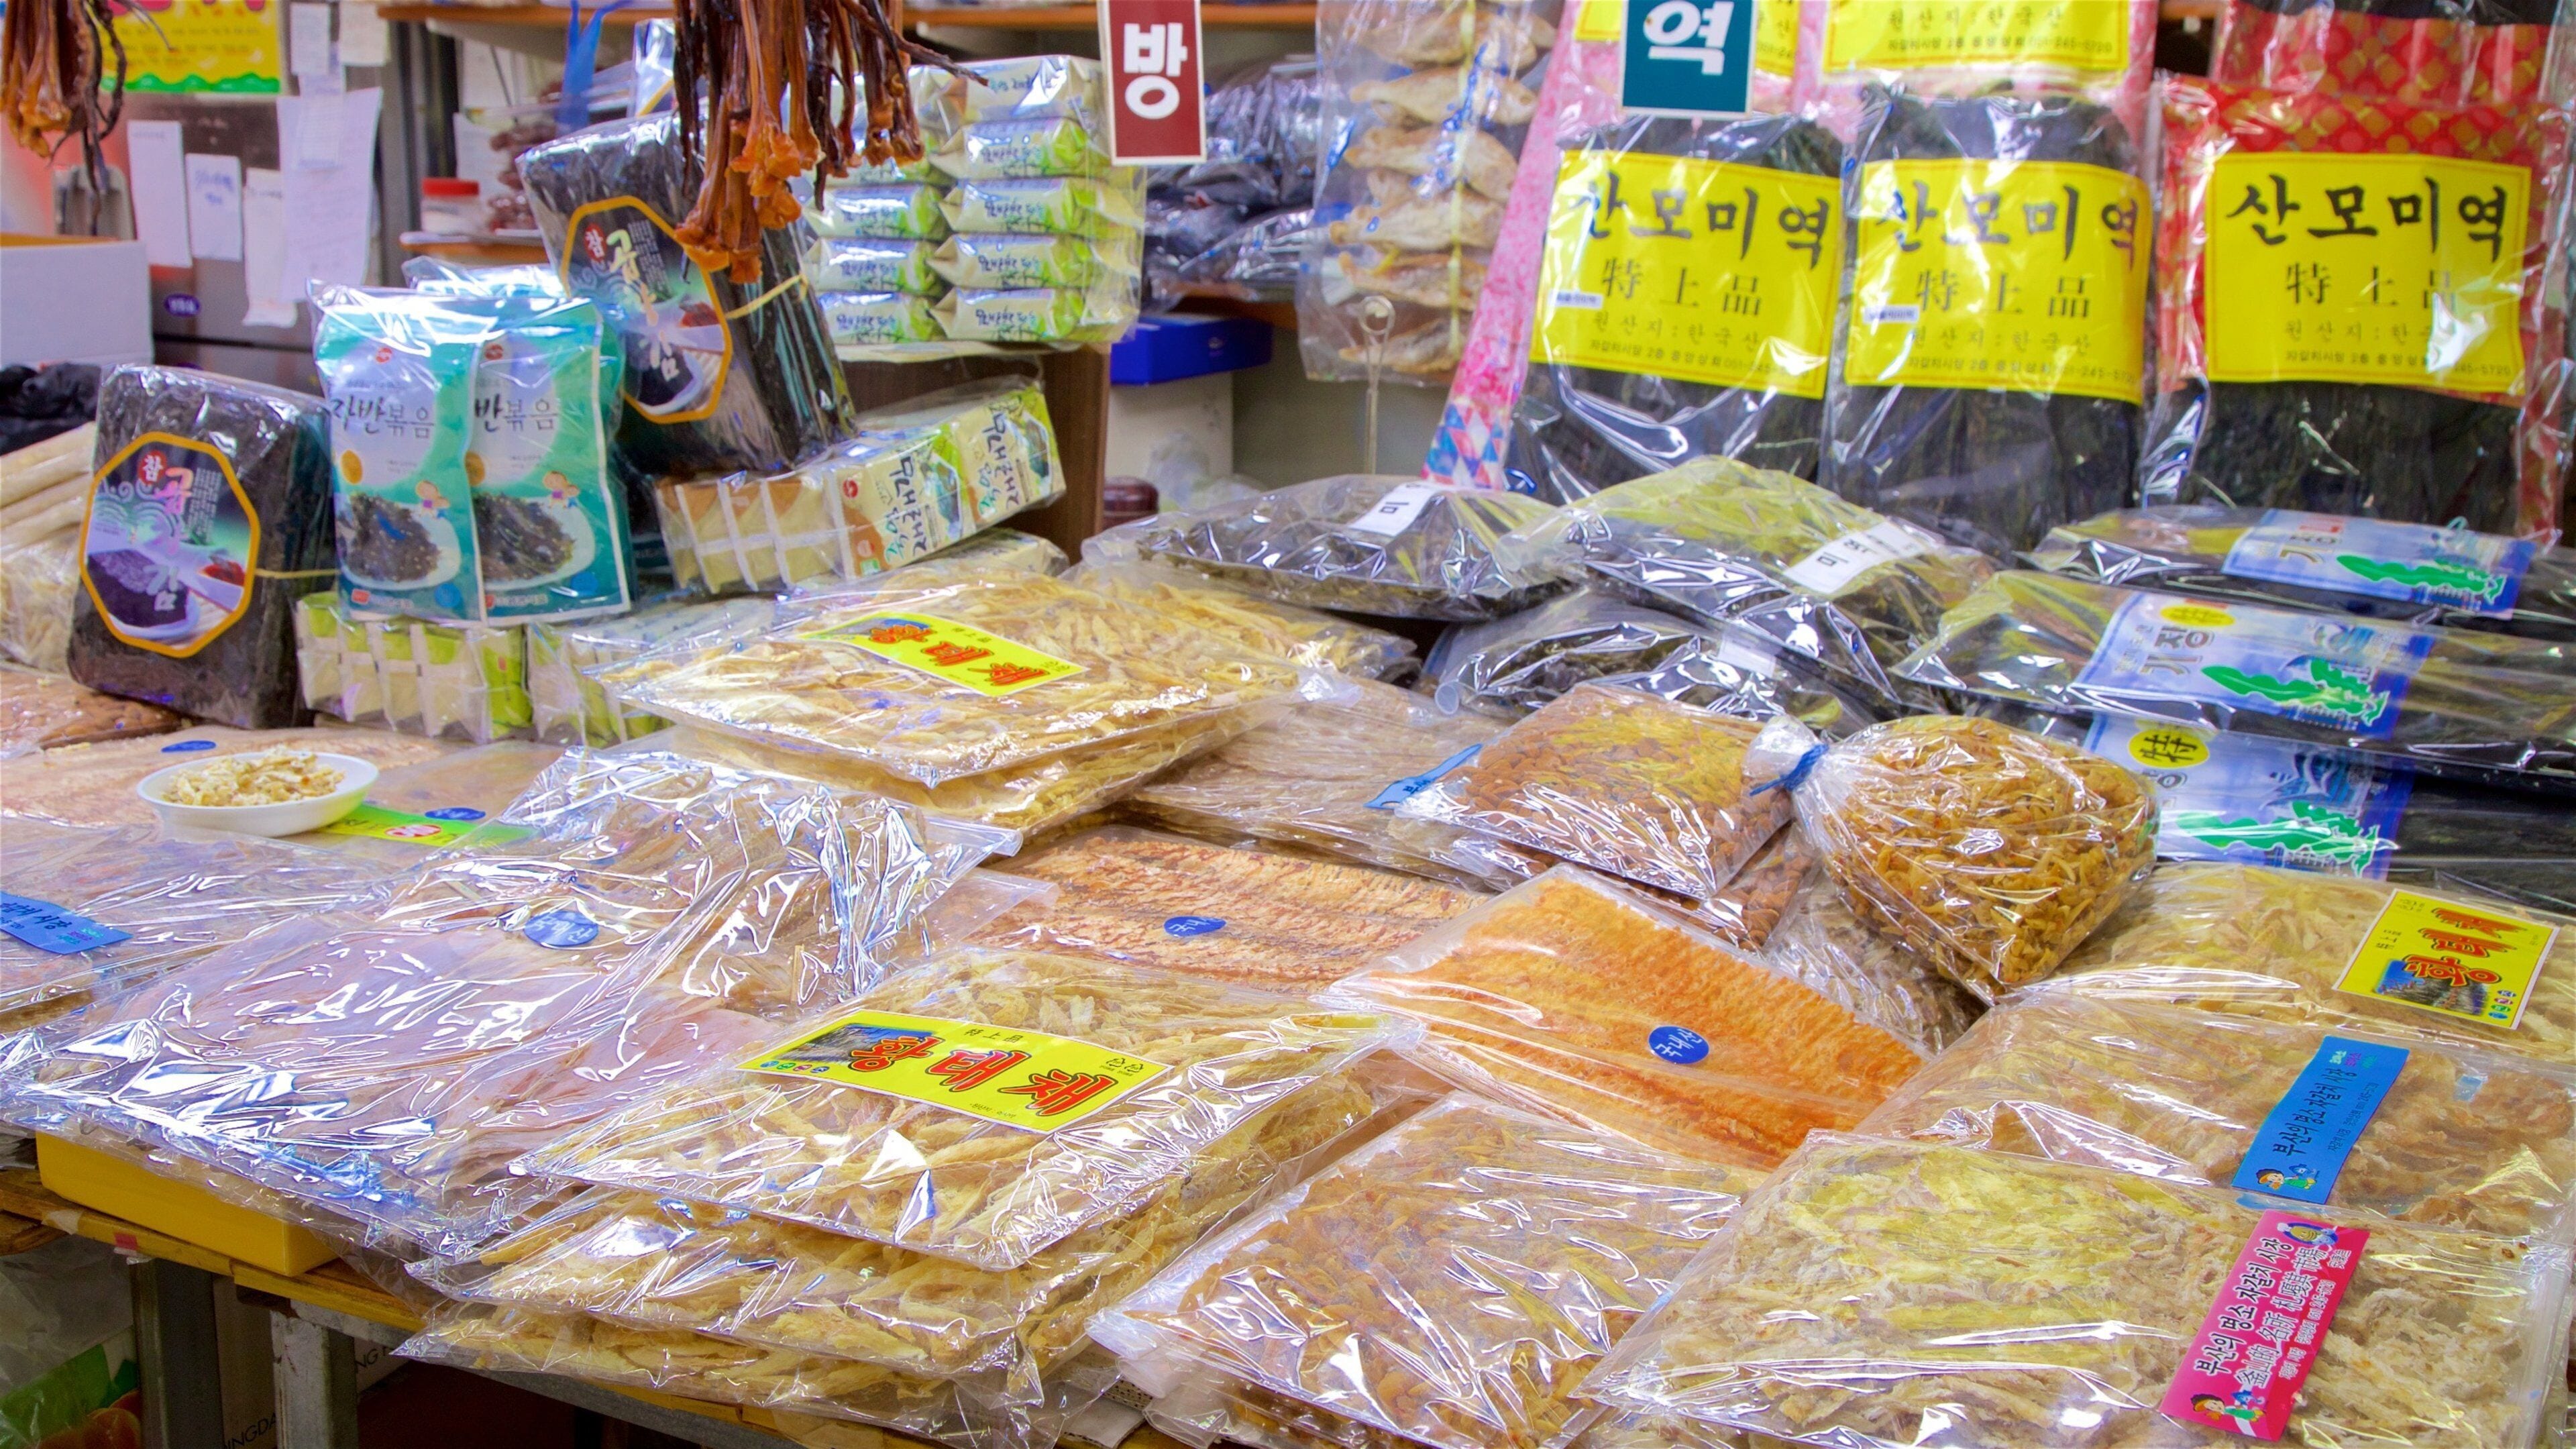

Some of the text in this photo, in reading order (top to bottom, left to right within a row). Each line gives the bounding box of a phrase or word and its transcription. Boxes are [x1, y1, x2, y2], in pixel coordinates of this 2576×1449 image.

[1124, 22, 1188, 119] 방
[1642, 0, 1732, 75] 역
[1570, 171, 1829, 271] 산모미역
[1876, 180, 2140, 272] 산모미역
[2226, 174, 2508, 263] 산모미역
[1601, 257, 1762, 316] 特上品
[1916, 270, 2089, 317] 特上品
[474, 393, 558, 433] 반볶음
[847, 1034, 1120, 1117] 황태채
[1654, 1028, 1703, 1057] 국내산
[2272, 1068, 2358, 1157] 부산의 명소 자갈치 시장
[2291, 1246, 2329, 1273] 市場
[2194, 1237, 2294, 1376] 부산의 명소 자갈치 시장
[2257, 1310, 2299, 1342] 名所
[2234, 1343, 2282, 1389] 釜山的
